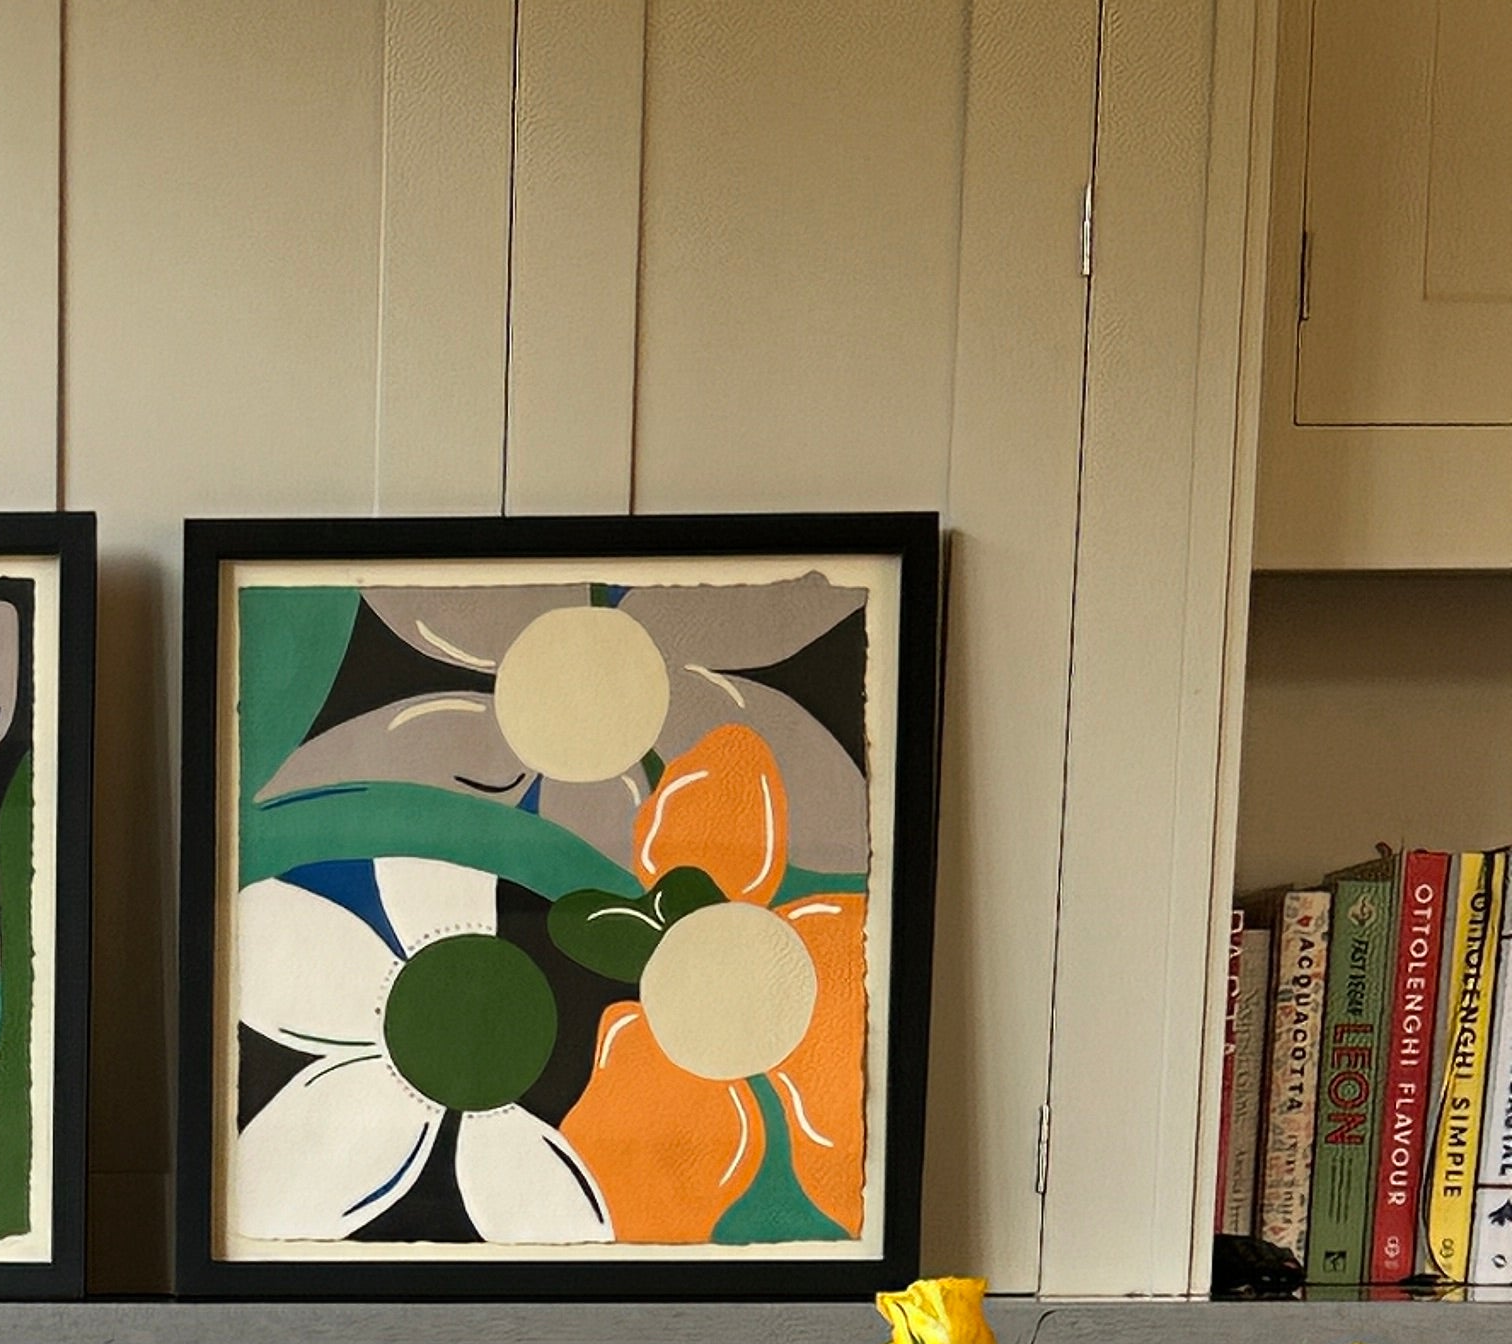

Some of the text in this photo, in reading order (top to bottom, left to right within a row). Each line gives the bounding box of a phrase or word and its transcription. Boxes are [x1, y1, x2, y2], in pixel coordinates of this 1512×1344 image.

[1288, 937, 1315, 1111] ACQUACOTTA
[1399, 883, 1433, 1066] OTTOLENGHI
[1325, 1022, 1374, 1146] LEON
[1387, 1082, 1416, 1206] FLAVOUR
[1444, 1097, 1471, 1198] SIMPLE
